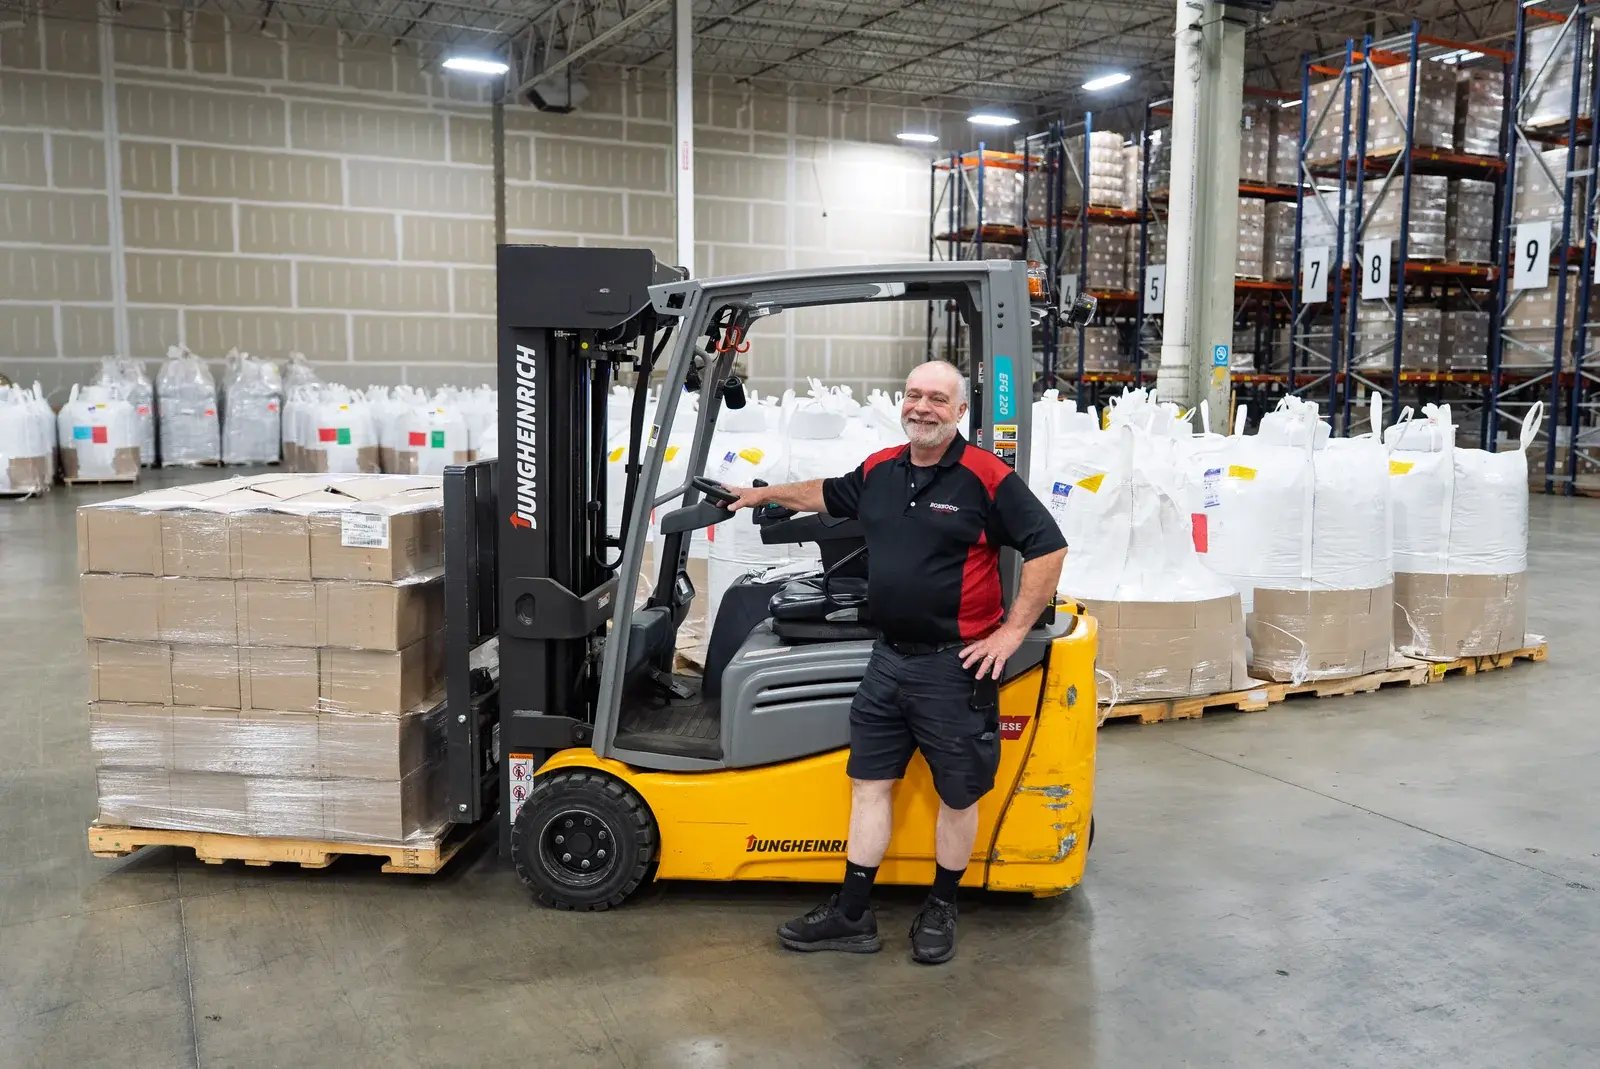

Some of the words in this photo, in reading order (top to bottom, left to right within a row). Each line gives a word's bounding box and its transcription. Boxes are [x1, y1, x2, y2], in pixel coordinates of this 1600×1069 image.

[1526, 239, 1539, 272] 9
[1310, 260, 1321, 289] 7
[1371, 254, 1382, 284] 8
[1064, 285, 1072, 308] 4
[1150, 277, 1160, 301] 5
[999, 372, 1009, 393] EFG
[999, 396, 1009, 415] 220
[516, 344, 537, 530] JUNGHEINRICH
[999, 722, 1022, 731] IESE
[746, 839, 848, 853] JUNGHEINRI
